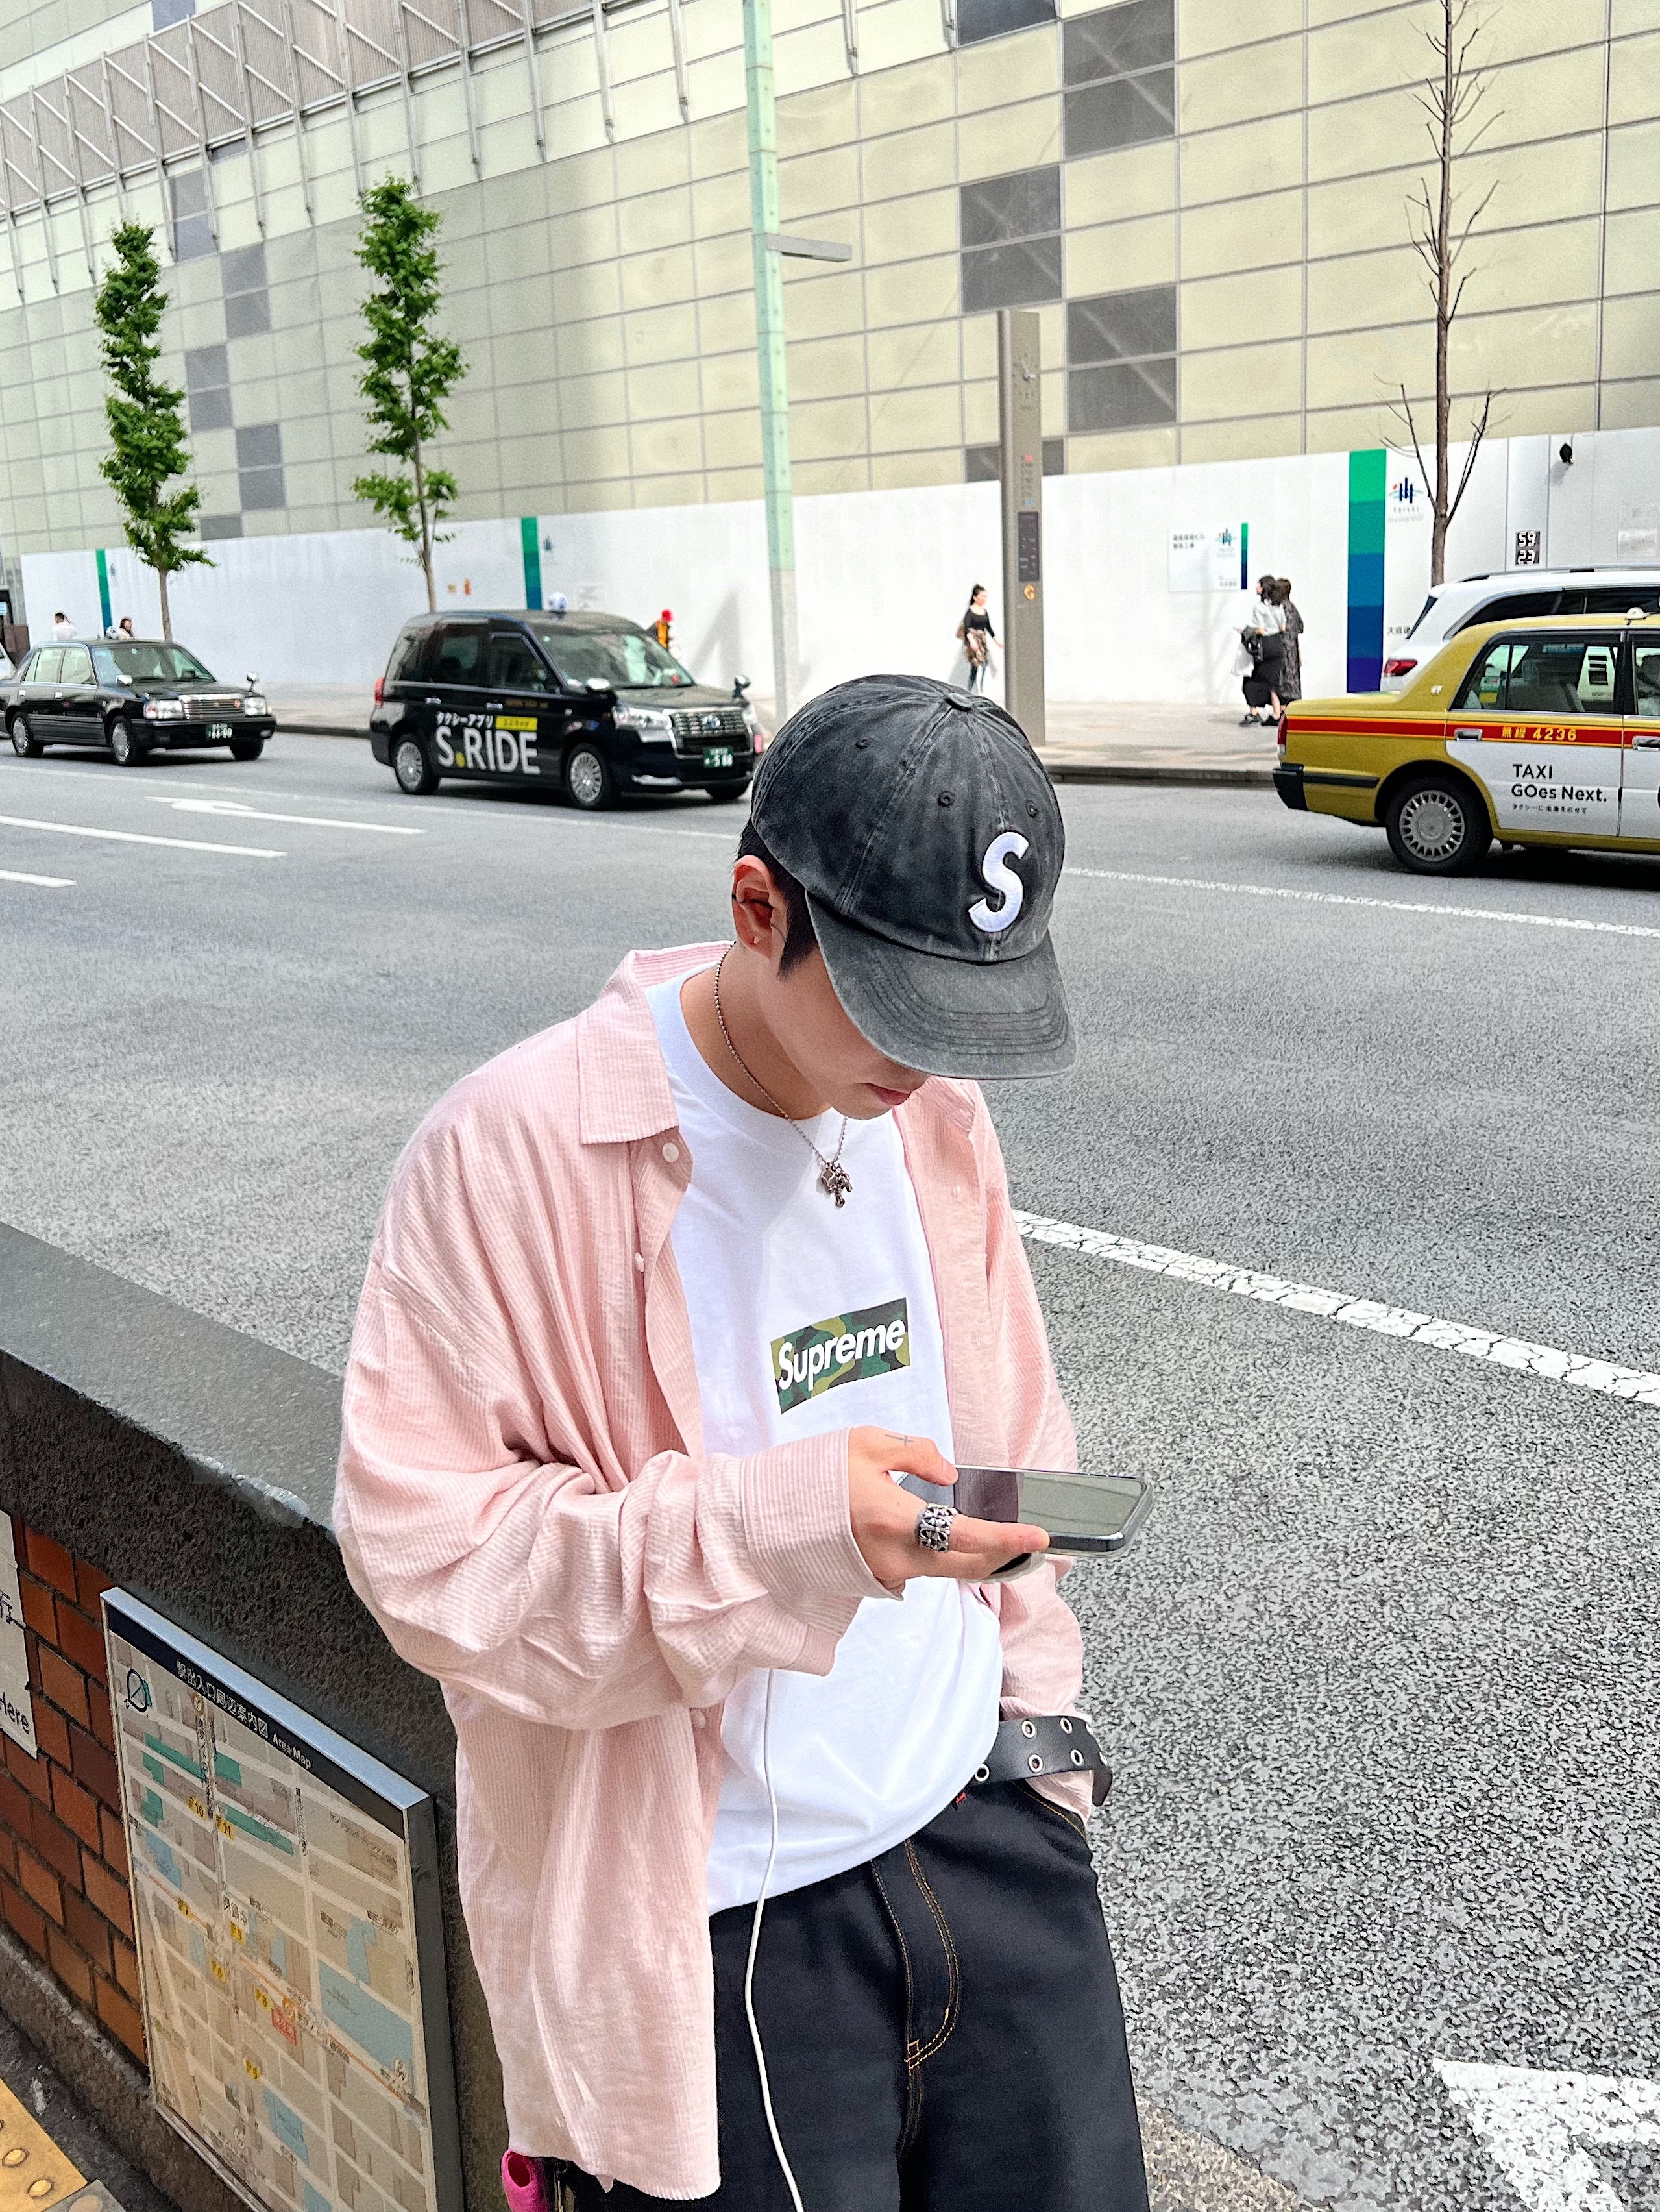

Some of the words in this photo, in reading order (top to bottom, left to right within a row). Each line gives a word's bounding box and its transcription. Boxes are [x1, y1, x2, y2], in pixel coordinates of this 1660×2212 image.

[1519, 532, 1535, 547] 59
[1518, 549, 1535, 565] 23
[1532, 727, 1577, 741] 4236
[436, 726, 541, 775] S.RIDE
[1513, 763, 1553, 780] TAXI
[1511, 783, 1557, 799] GOes
[1561, 786, 1607, 802] Next.
[968, 831, 1030, 933] S
[778, 1320, 906, 1392] Supreme
[273, 1732, 291, 1754] Area
[291, 1746, 311, 1770] Map
